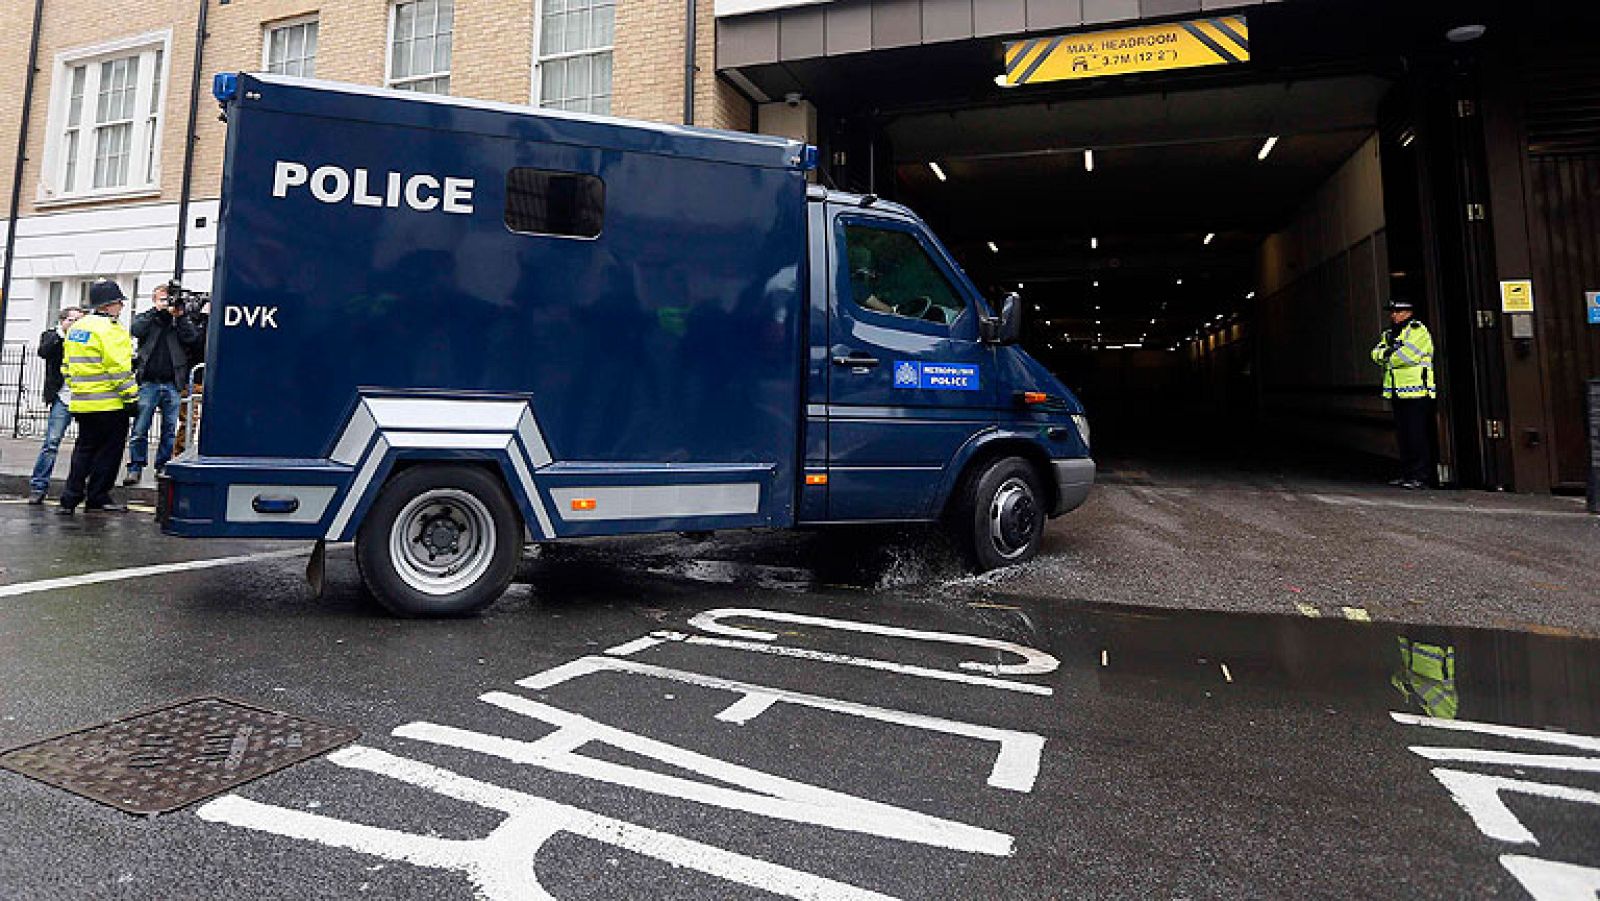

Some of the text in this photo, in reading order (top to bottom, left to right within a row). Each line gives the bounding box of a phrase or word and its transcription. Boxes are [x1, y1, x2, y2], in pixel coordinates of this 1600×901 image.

[1067, 33, 1178, 54] MAX. HEADROOM
[1102, 54, 1130, 66] 3.7M
[272, 160, 475, 214] POLICE
[224, 305, 278, 328] DVK
[930, 376, 968, 387] POLICE
